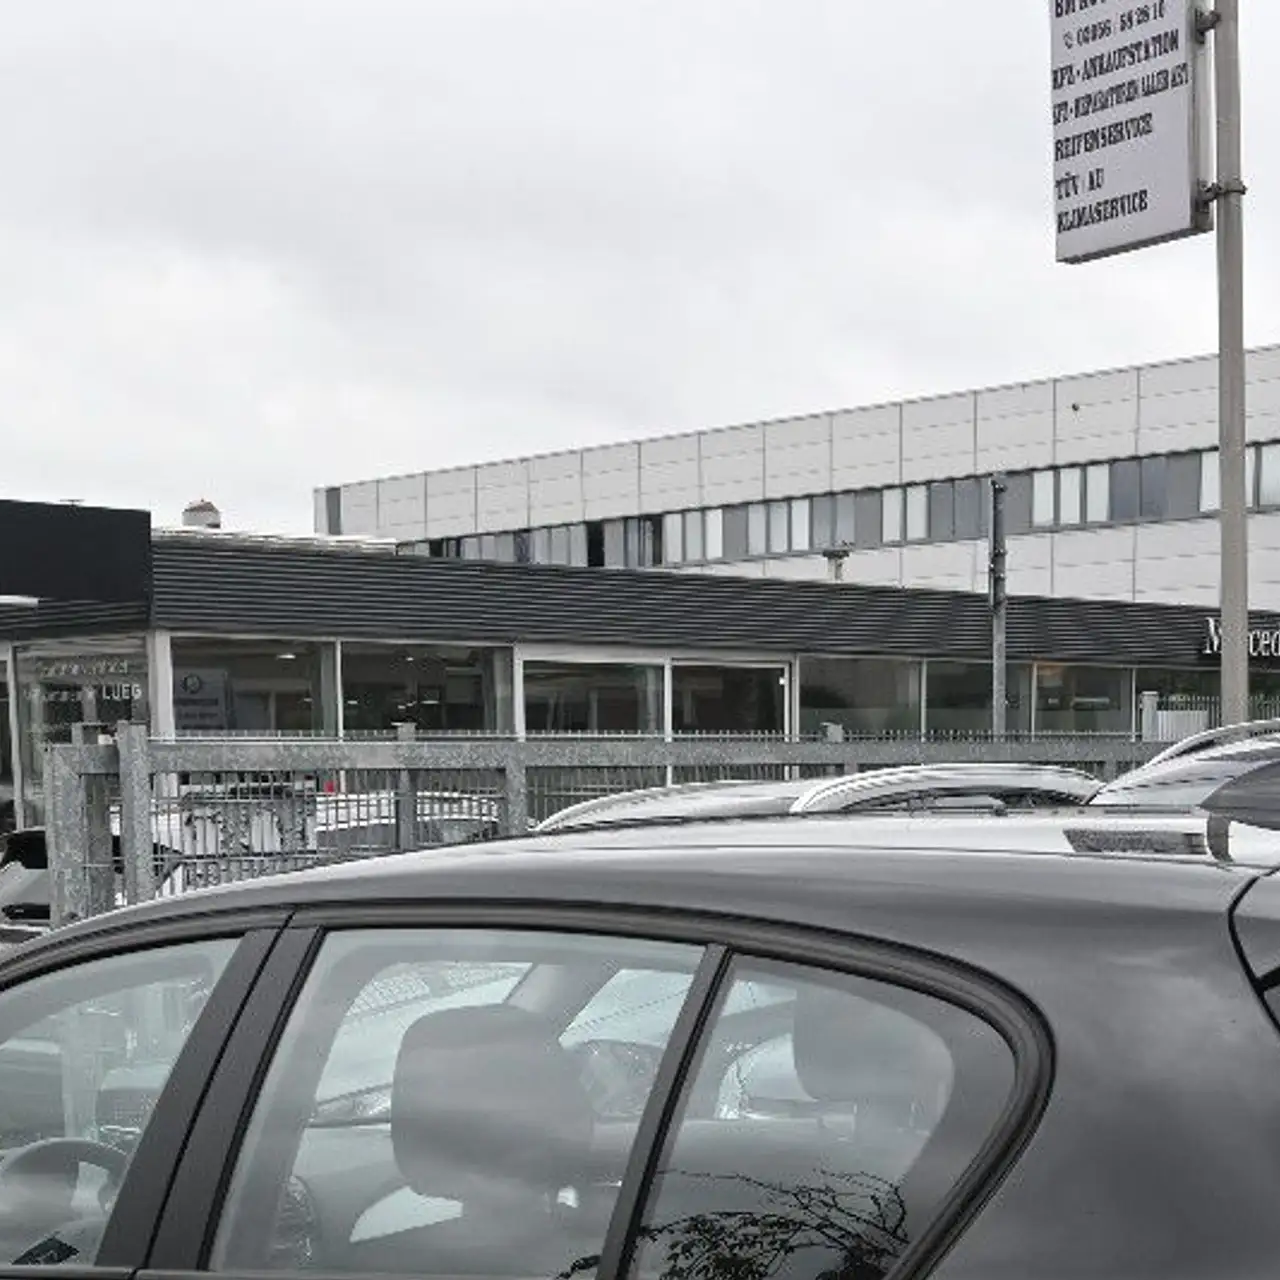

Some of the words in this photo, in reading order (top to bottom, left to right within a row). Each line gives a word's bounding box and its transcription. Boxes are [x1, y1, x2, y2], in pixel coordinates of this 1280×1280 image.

[1055, 112, 1153, 161] REIFENSERVICE
[1057, 189, 1148, 233] KLIMASERVICE
[101, 683, 142, 700] LUEG
